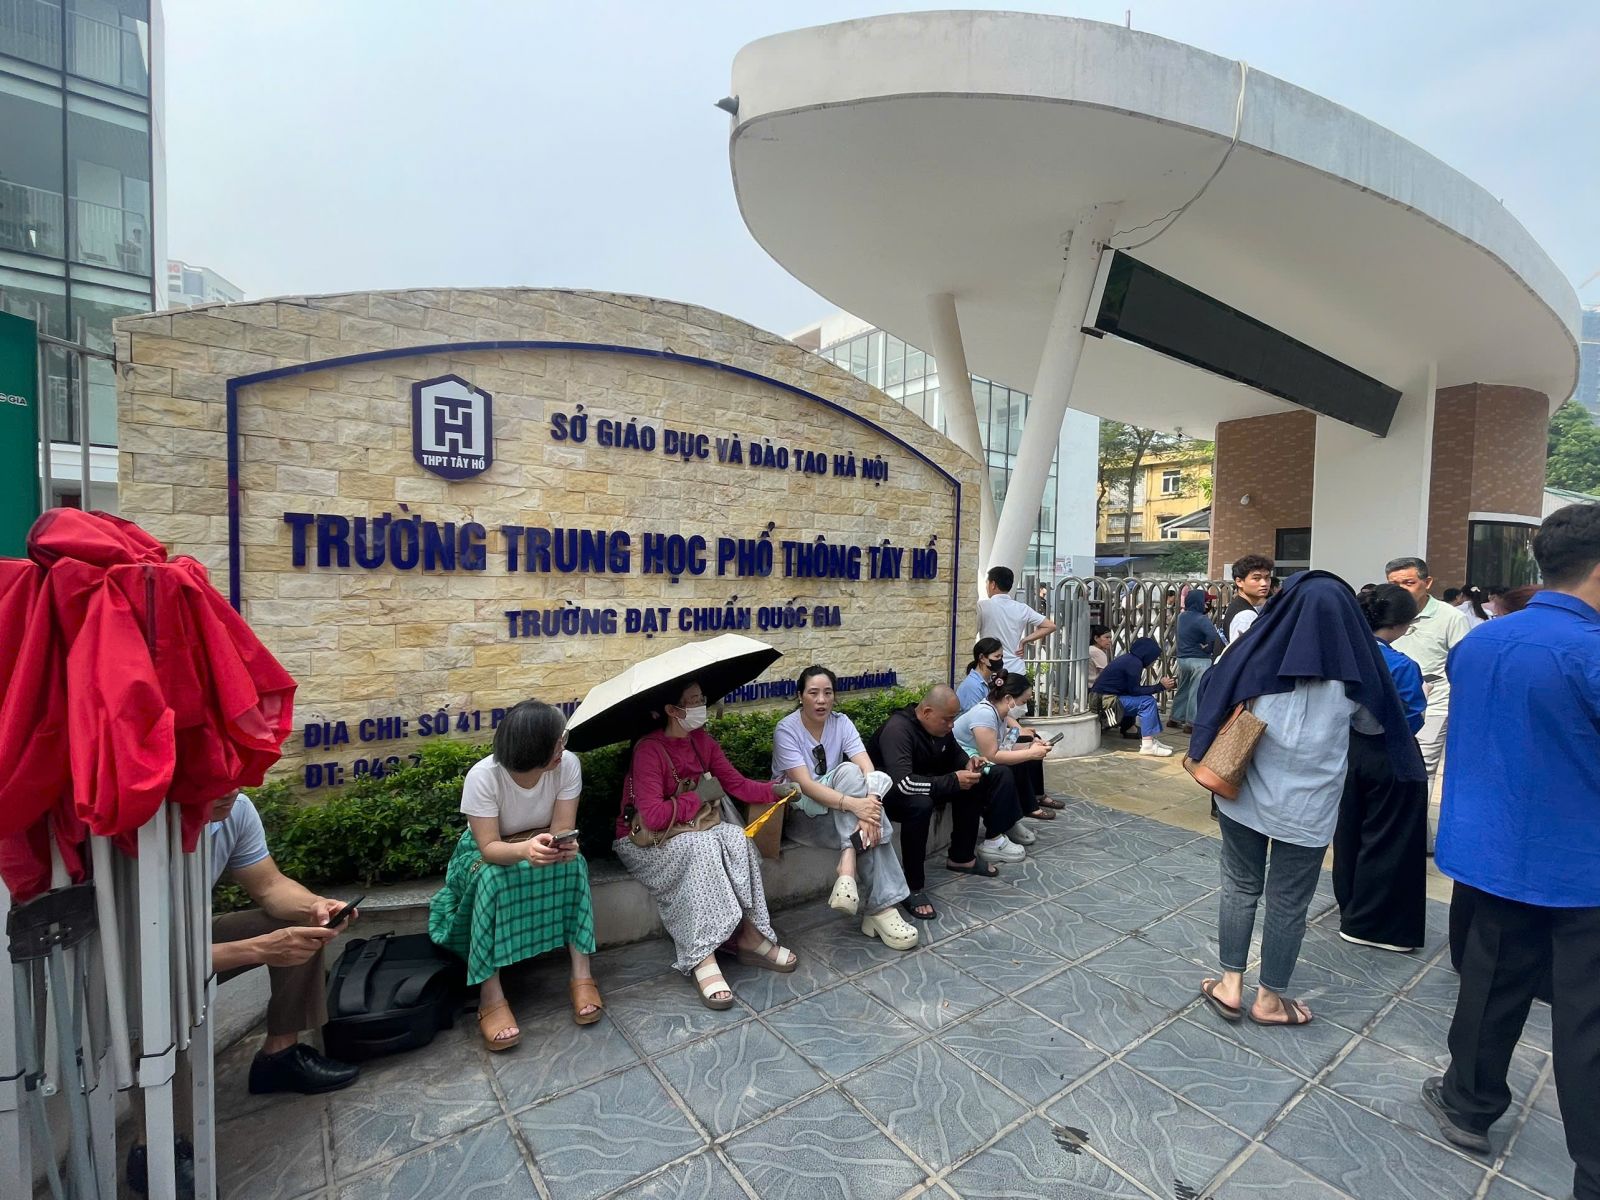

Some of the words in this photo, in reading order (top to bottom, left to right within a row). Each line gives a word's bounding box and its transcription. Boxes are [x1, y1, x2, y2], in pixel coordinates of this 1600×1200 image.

[422, 454, 448, 467] THPT
[450, 455, 469, 469] TÂY
[550, 403, 588, 443] SỞ
[597, 416, 656, 452] GIÁO
[663, 428, 710, 462] DỤC
[715, 432, 743, 464] VÀ
[833, 450, 857, 477] HÀ
[861, 454, 889, 488] NỘI
[283, 502, 487, 571] TRƯỜNG
[501, 525, 631, 574] TRUNG
[642, 532, 707, 584] HỌC
[717, 521, 775, 578] PHỔ
[781, 534, 862, 580] THÔNG
[868, 538, 905, 579] TÂY
[505, 600, 618, 639] TRƯỜNG
[625, 607, 672, 639] ĐẠT
[678, 594, 752, 632] CHUẨN
[757, 596, 808, 632] QUỐC
[813, 605, 842, 628] GIA
[304, 720, 350, 752] ĐỊA
[417, 698, 449, 737] SỐ
[455, 709, 482, 733] 41
[760, 678, 799, 700] THƯỢN
